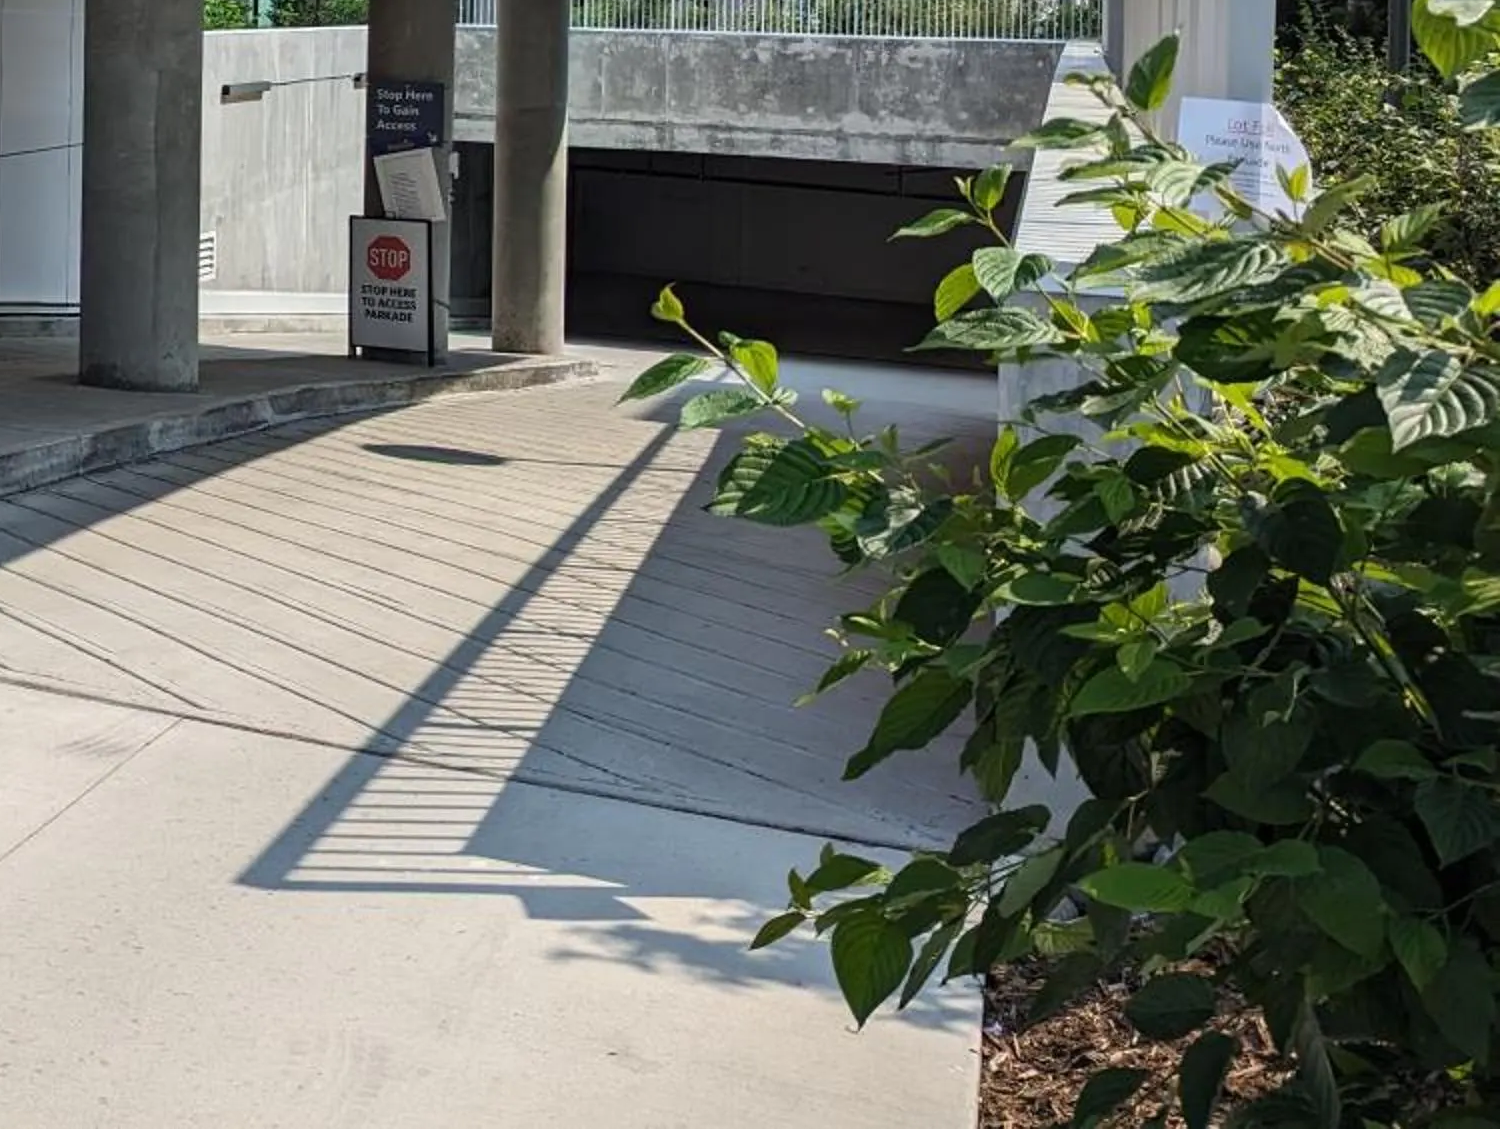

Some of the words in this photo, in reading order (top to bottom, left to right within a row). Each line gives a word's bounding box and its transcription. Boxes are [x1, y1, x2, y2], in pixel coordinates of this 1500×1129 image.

[376, 88, 403, 102] Stop
[405, 89, 434, 102] Here
[377, 104, 390, 116] To
[393, 104, 419, 116] Gain
[376, 119, 417, 131] Access
[369, 248, 408, 268] STOP
[361, 284, 388, 296] STOP
[389, 286, 417, 298] HERE
[362, 296, 376, 308] TO
[378, 297, 417, 310] ACCESS
[365, 308, 413, 323] PARKADE
